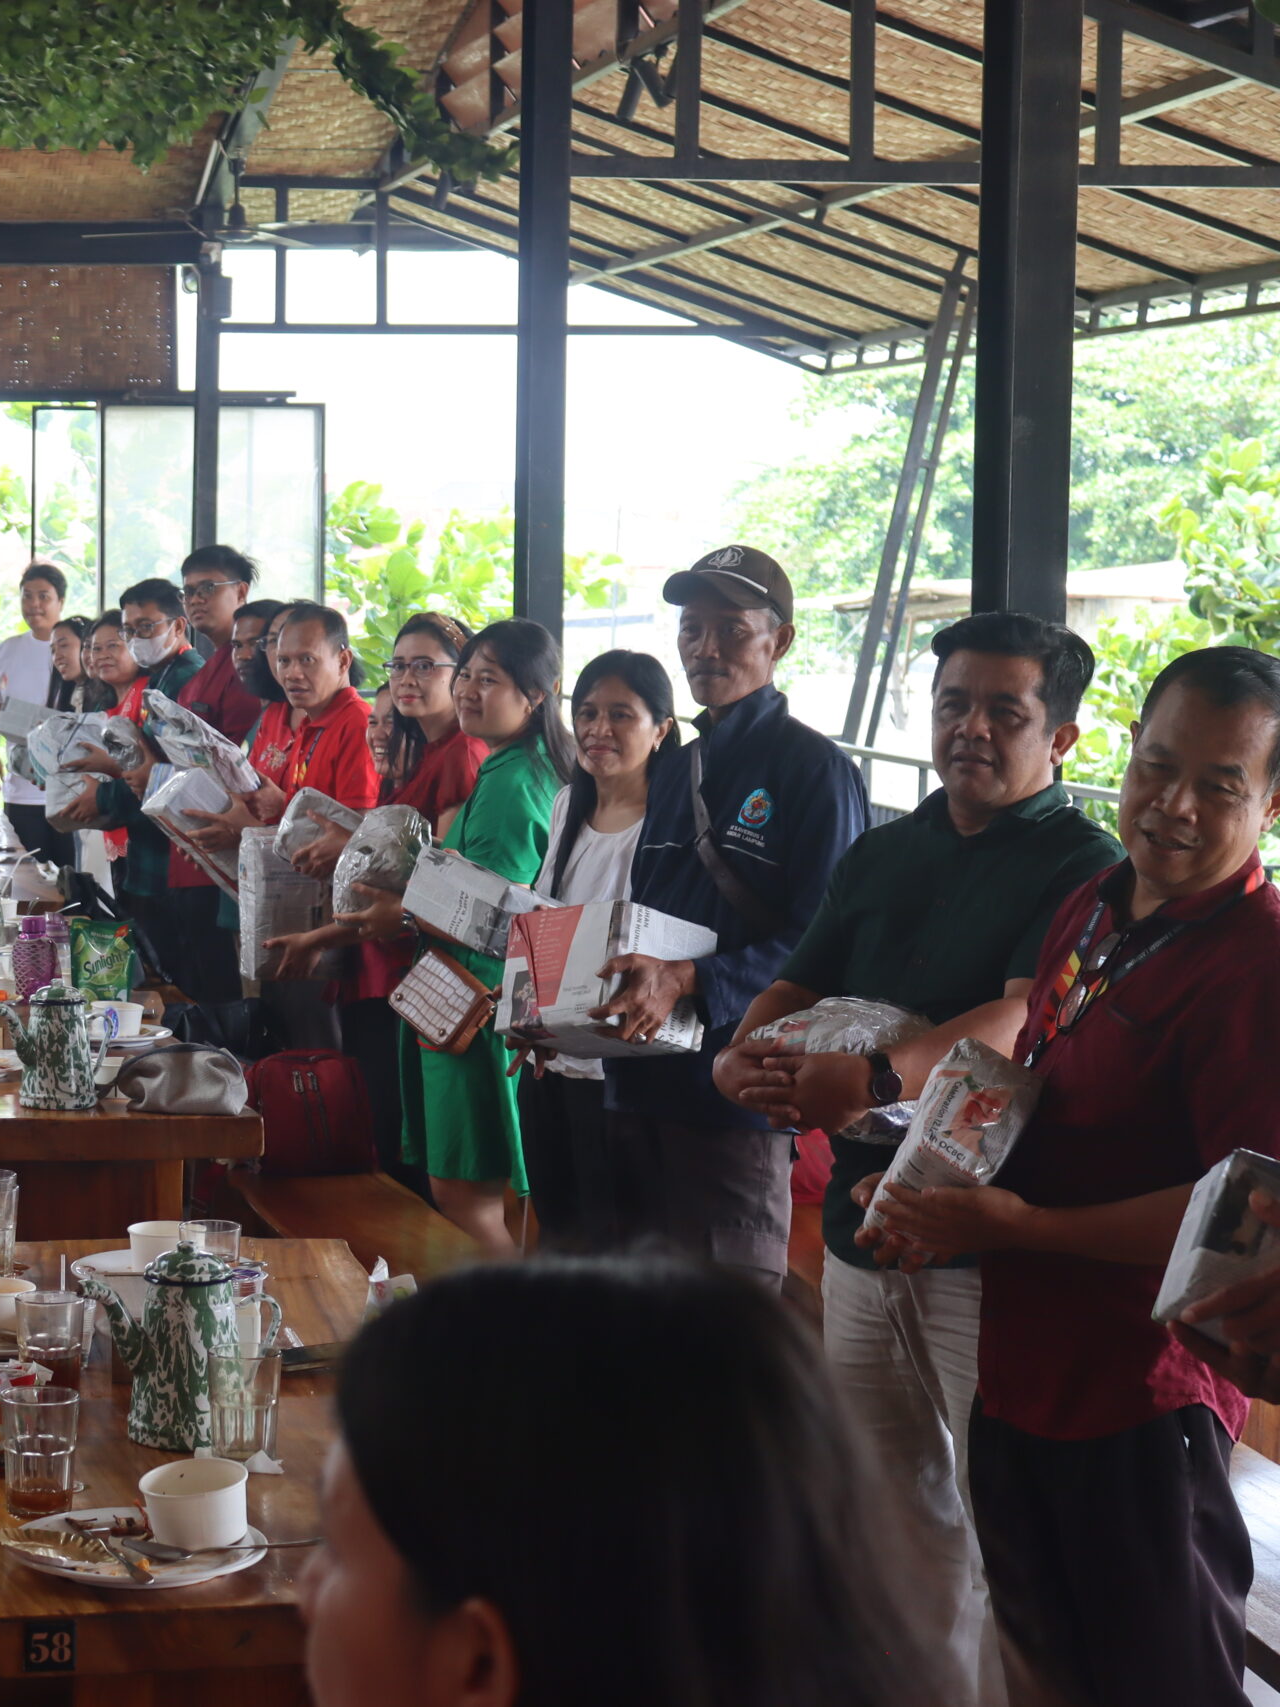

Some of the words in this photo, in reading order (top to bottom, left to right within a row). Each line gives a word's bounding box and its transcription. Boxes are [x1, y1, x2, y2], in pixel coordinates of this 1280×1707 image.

[83, 952, 125, 981] Sunlight
[938, 1080, 963, 1119] Celebration
[29, 1631, 72, 1664] 58
